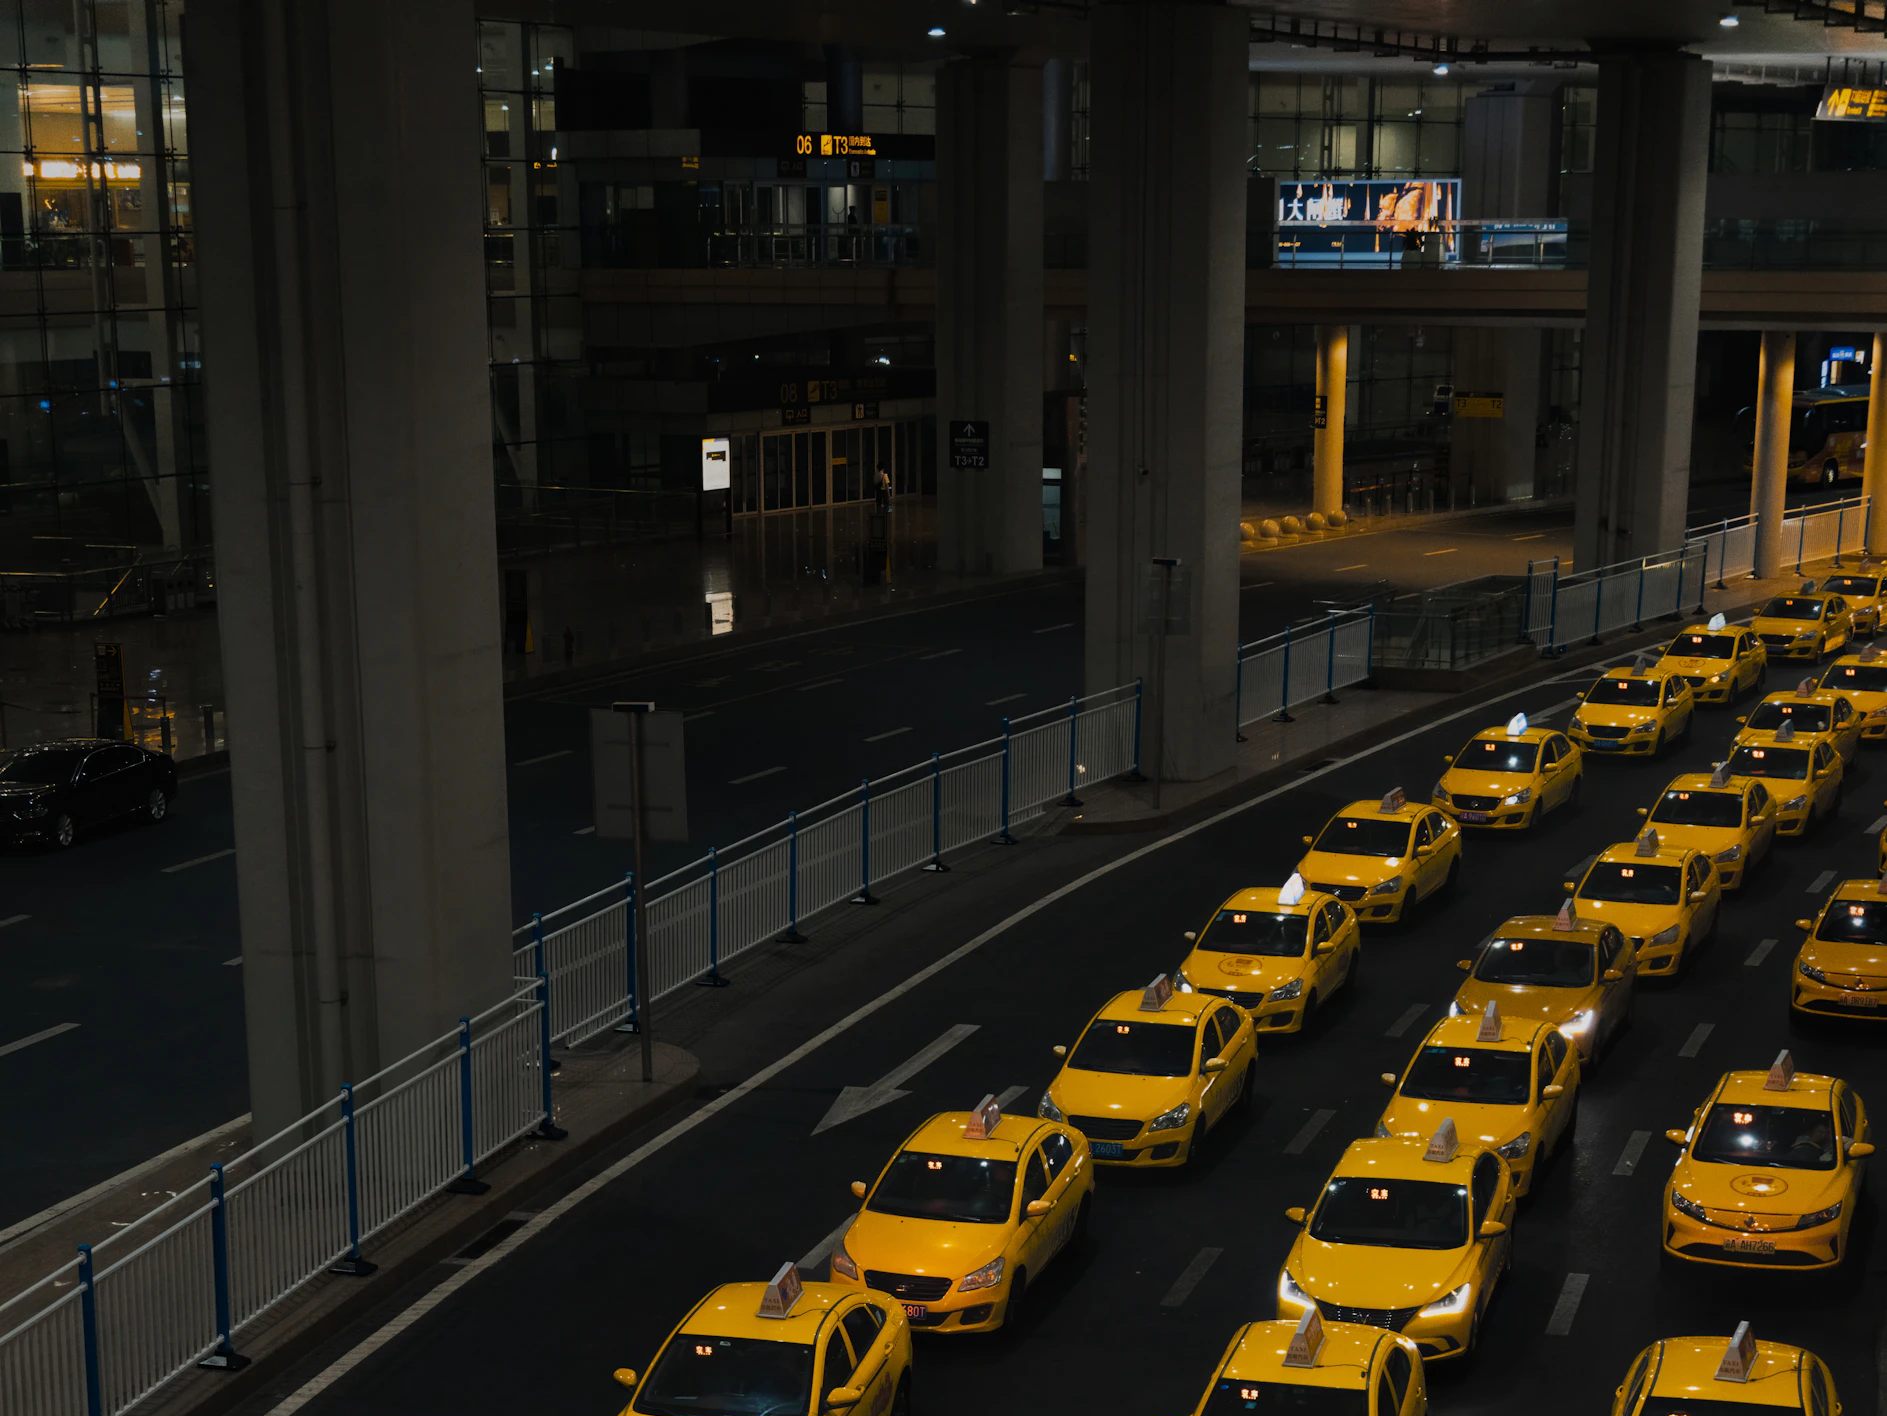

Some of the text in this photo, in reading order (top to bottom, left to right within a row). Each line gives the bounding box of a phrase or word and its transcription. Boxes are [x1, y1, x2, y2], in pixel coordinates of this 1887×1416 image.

[796, 134, 849, 155] 06 T3
[780, 381, 798, 404] 08
[821, 379, 838, 400] T3
[1455, 398, 1502, 409] T3 T2
[954, 455, 985, 466] T3 T2
[1095, 1143, 1121, 1155] 2603T
[1740, 1240, 1775, 1253] AH7266
